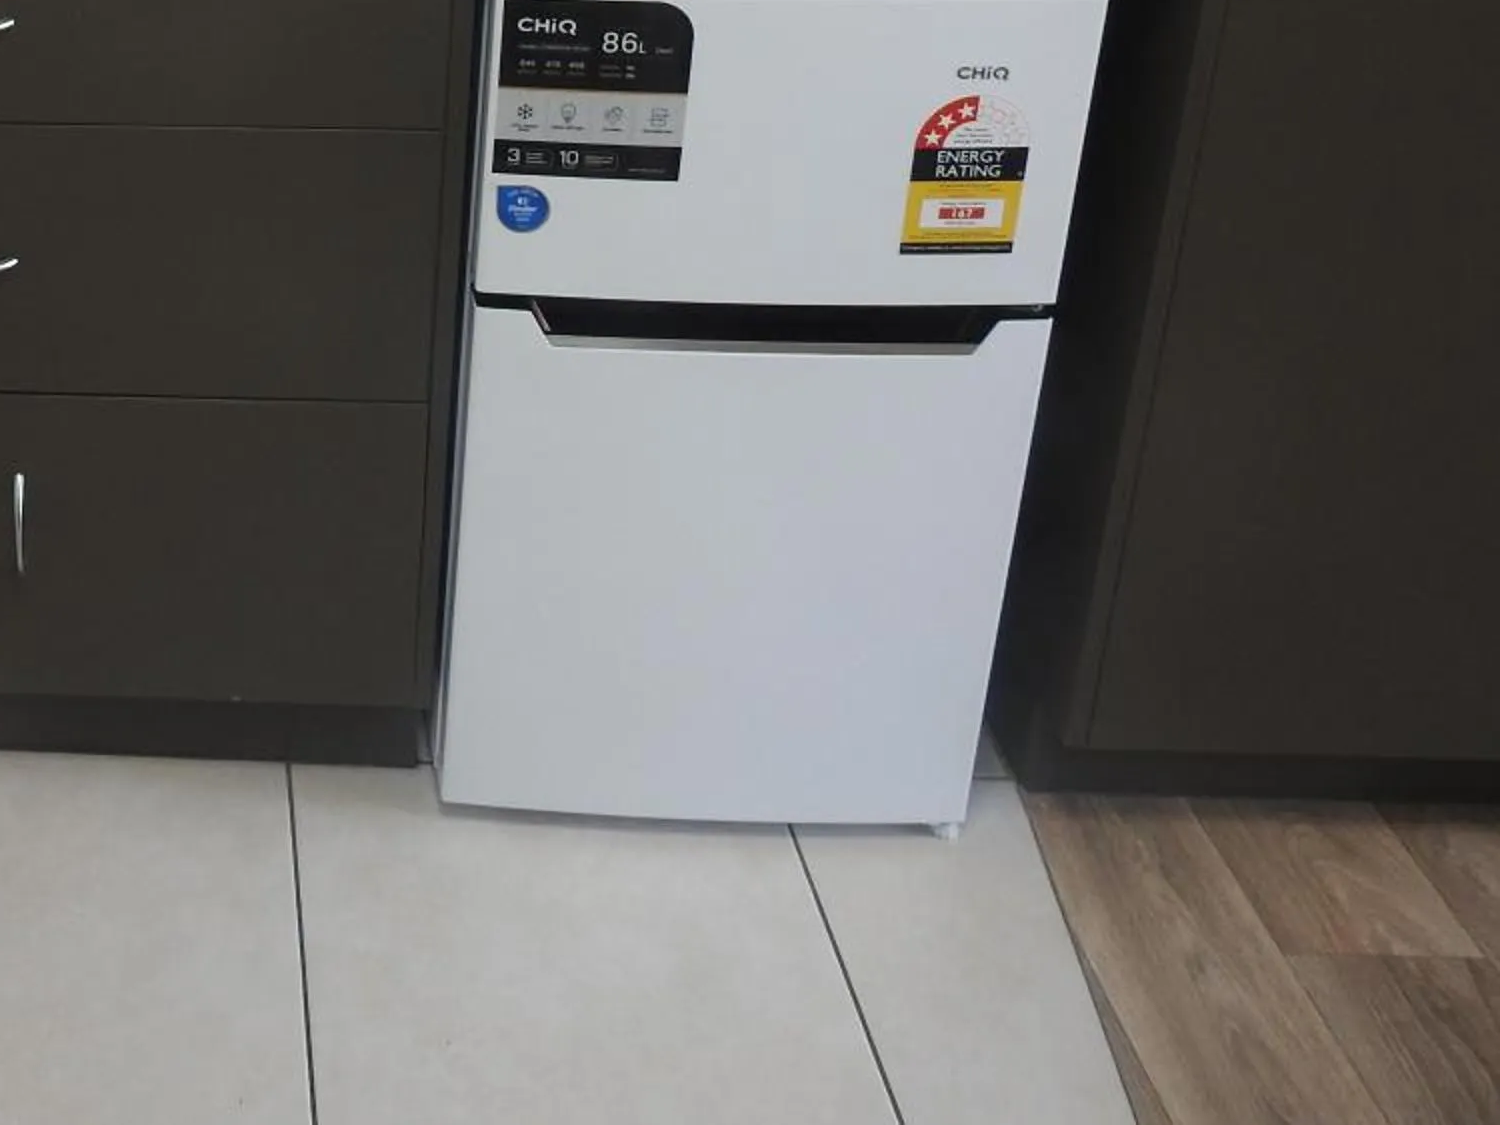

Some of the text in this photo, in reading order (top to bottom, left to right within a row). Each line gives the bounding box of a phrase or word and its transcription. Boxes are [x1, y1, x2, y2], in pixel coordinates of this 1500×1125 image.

[517, 17, 577, 36] CHiQ
[956, 66, 1010, 81] CHiQ
[507, 148, 521, 162] 3
[559, 150, 580, 166] 10
[937, 150, 1004, 164] ENERGY
[935, 164, 1003, 178] RATING
